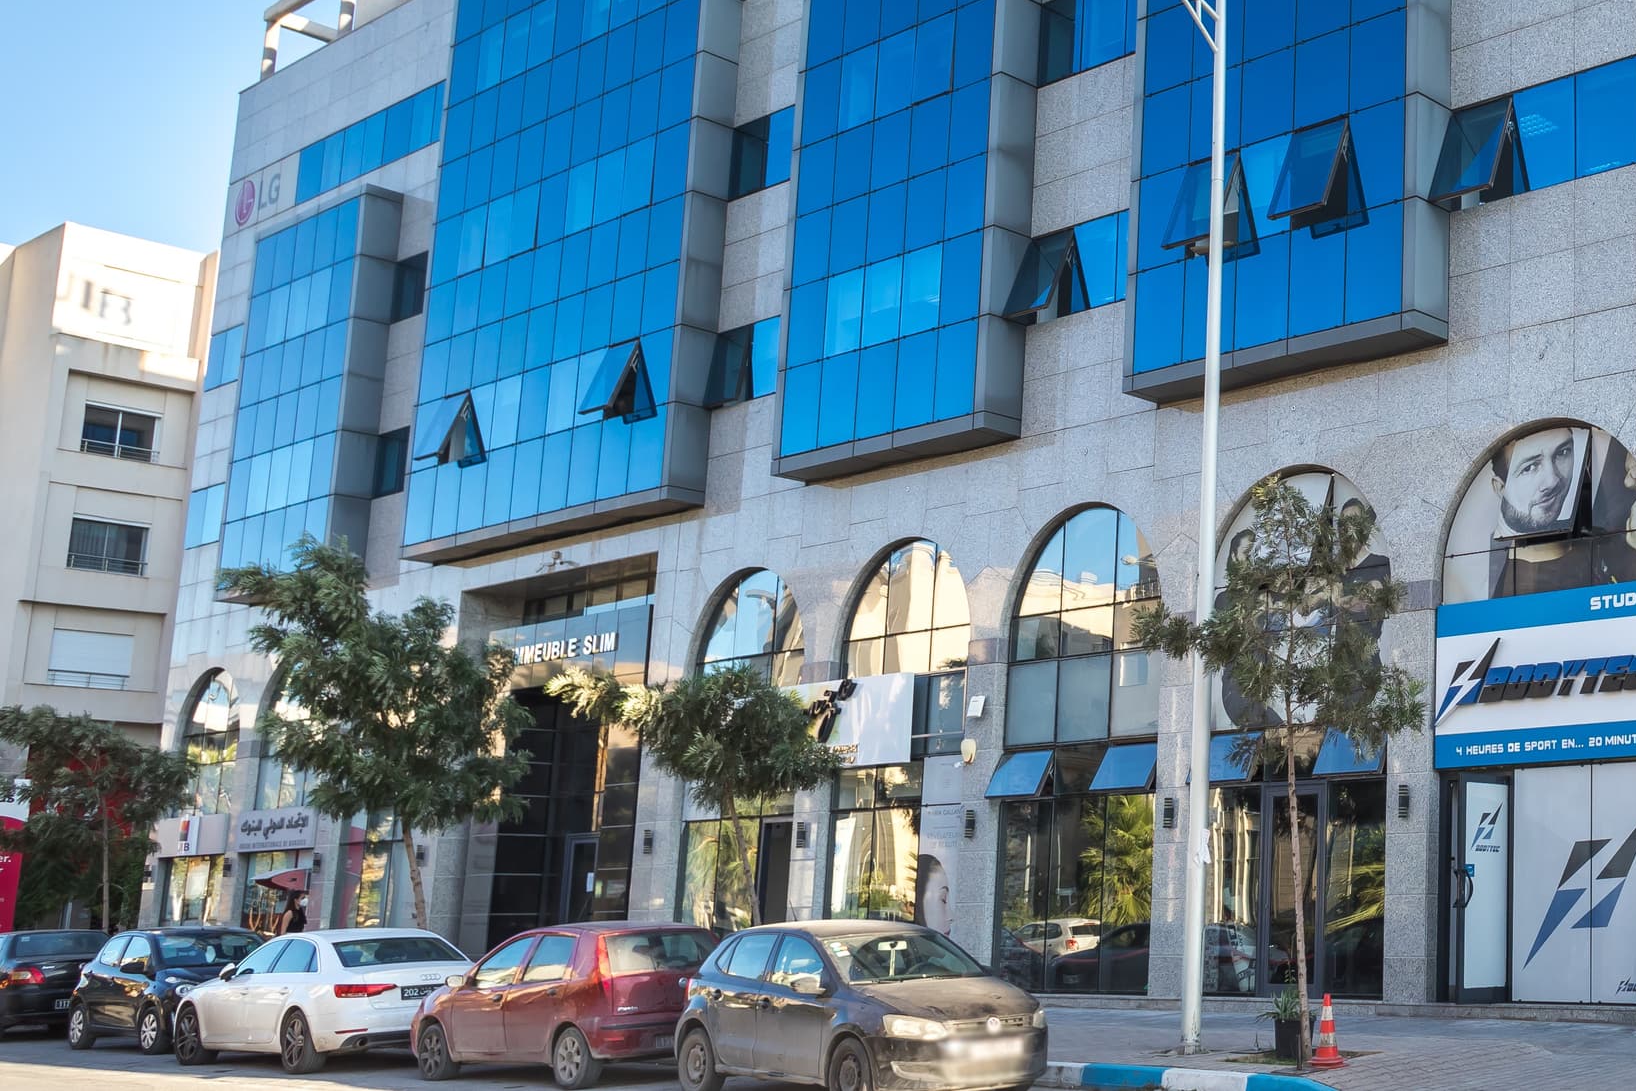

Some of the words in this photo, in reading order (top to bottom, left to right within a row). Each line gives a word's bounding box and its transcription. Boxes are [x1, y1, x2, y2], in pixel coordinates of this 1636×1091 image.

[511, 638, 579, 666] MMEUBLE
[583, 632, 617, 656] SLIM
[1455, 746, 1463, 756] 4
[1466, 743, 1504, 756] HEURES
[1508, 742, 1520, 753] DE
[1525, 739, 1557, 752] SPORT
[1561, 738, 1584, 749] EN...
[1588, 736, 1602, 747] 20
[403, 988, 419, 997] 202
